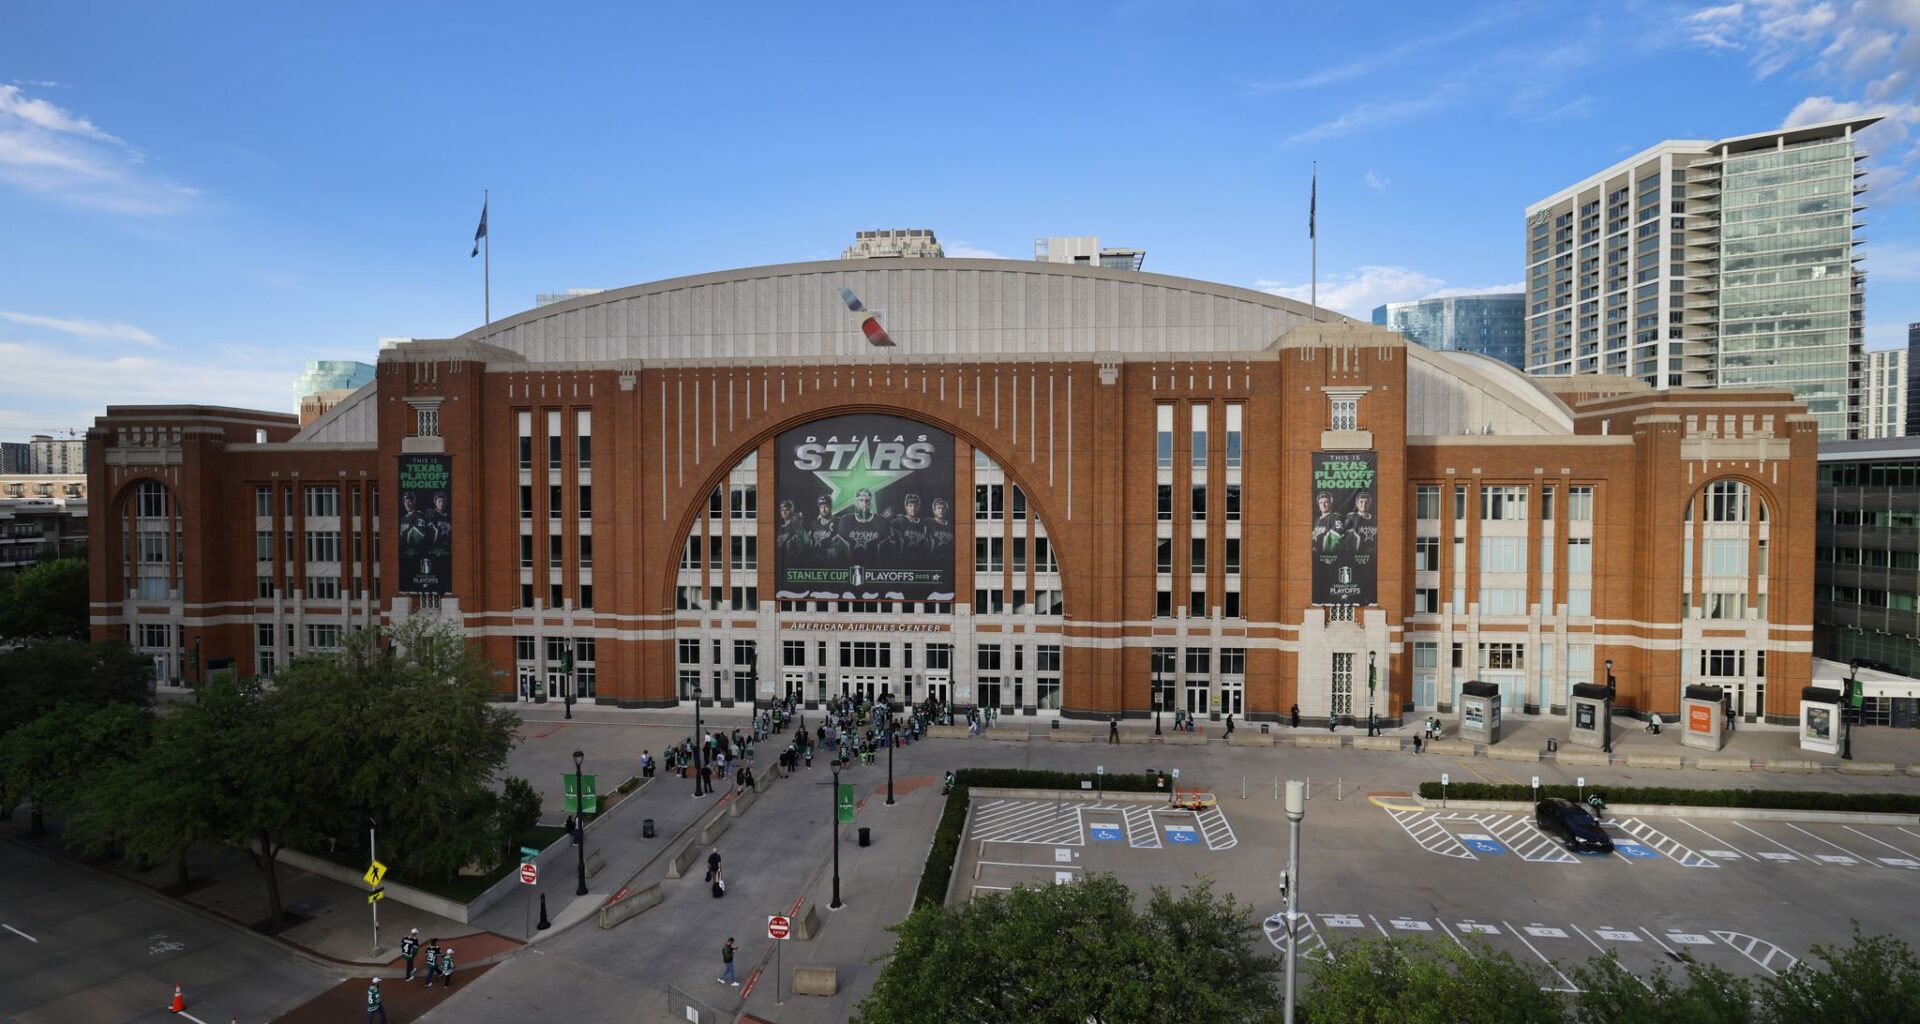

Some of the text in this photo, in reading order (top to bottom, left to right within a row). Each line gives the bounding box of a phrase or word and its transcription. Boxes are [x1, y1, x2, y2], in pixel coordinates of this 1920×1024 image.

[806, 434, 928, 443] DALLAS
[794, 441, 935, 470] STARS
[406, 464, 443, 472] TEXAS
[1322, 462, 1367, 470] TEXAS
[400, 472, 449, 480] PLAYOFF
[1315, 471, 1374, 479] PLAYOFF
[402, 480, 448, 488] HOCKEY
[1317, 480, 1372, 488] HOCKEY
[787, 571, 827, 580] STANLEY
[830, 571, 848, 580] CUP
[865, 572, 914, 581] PLAYOFFS
[791, 622, 940, 632] AMERICAN AIRLINES CENTER
